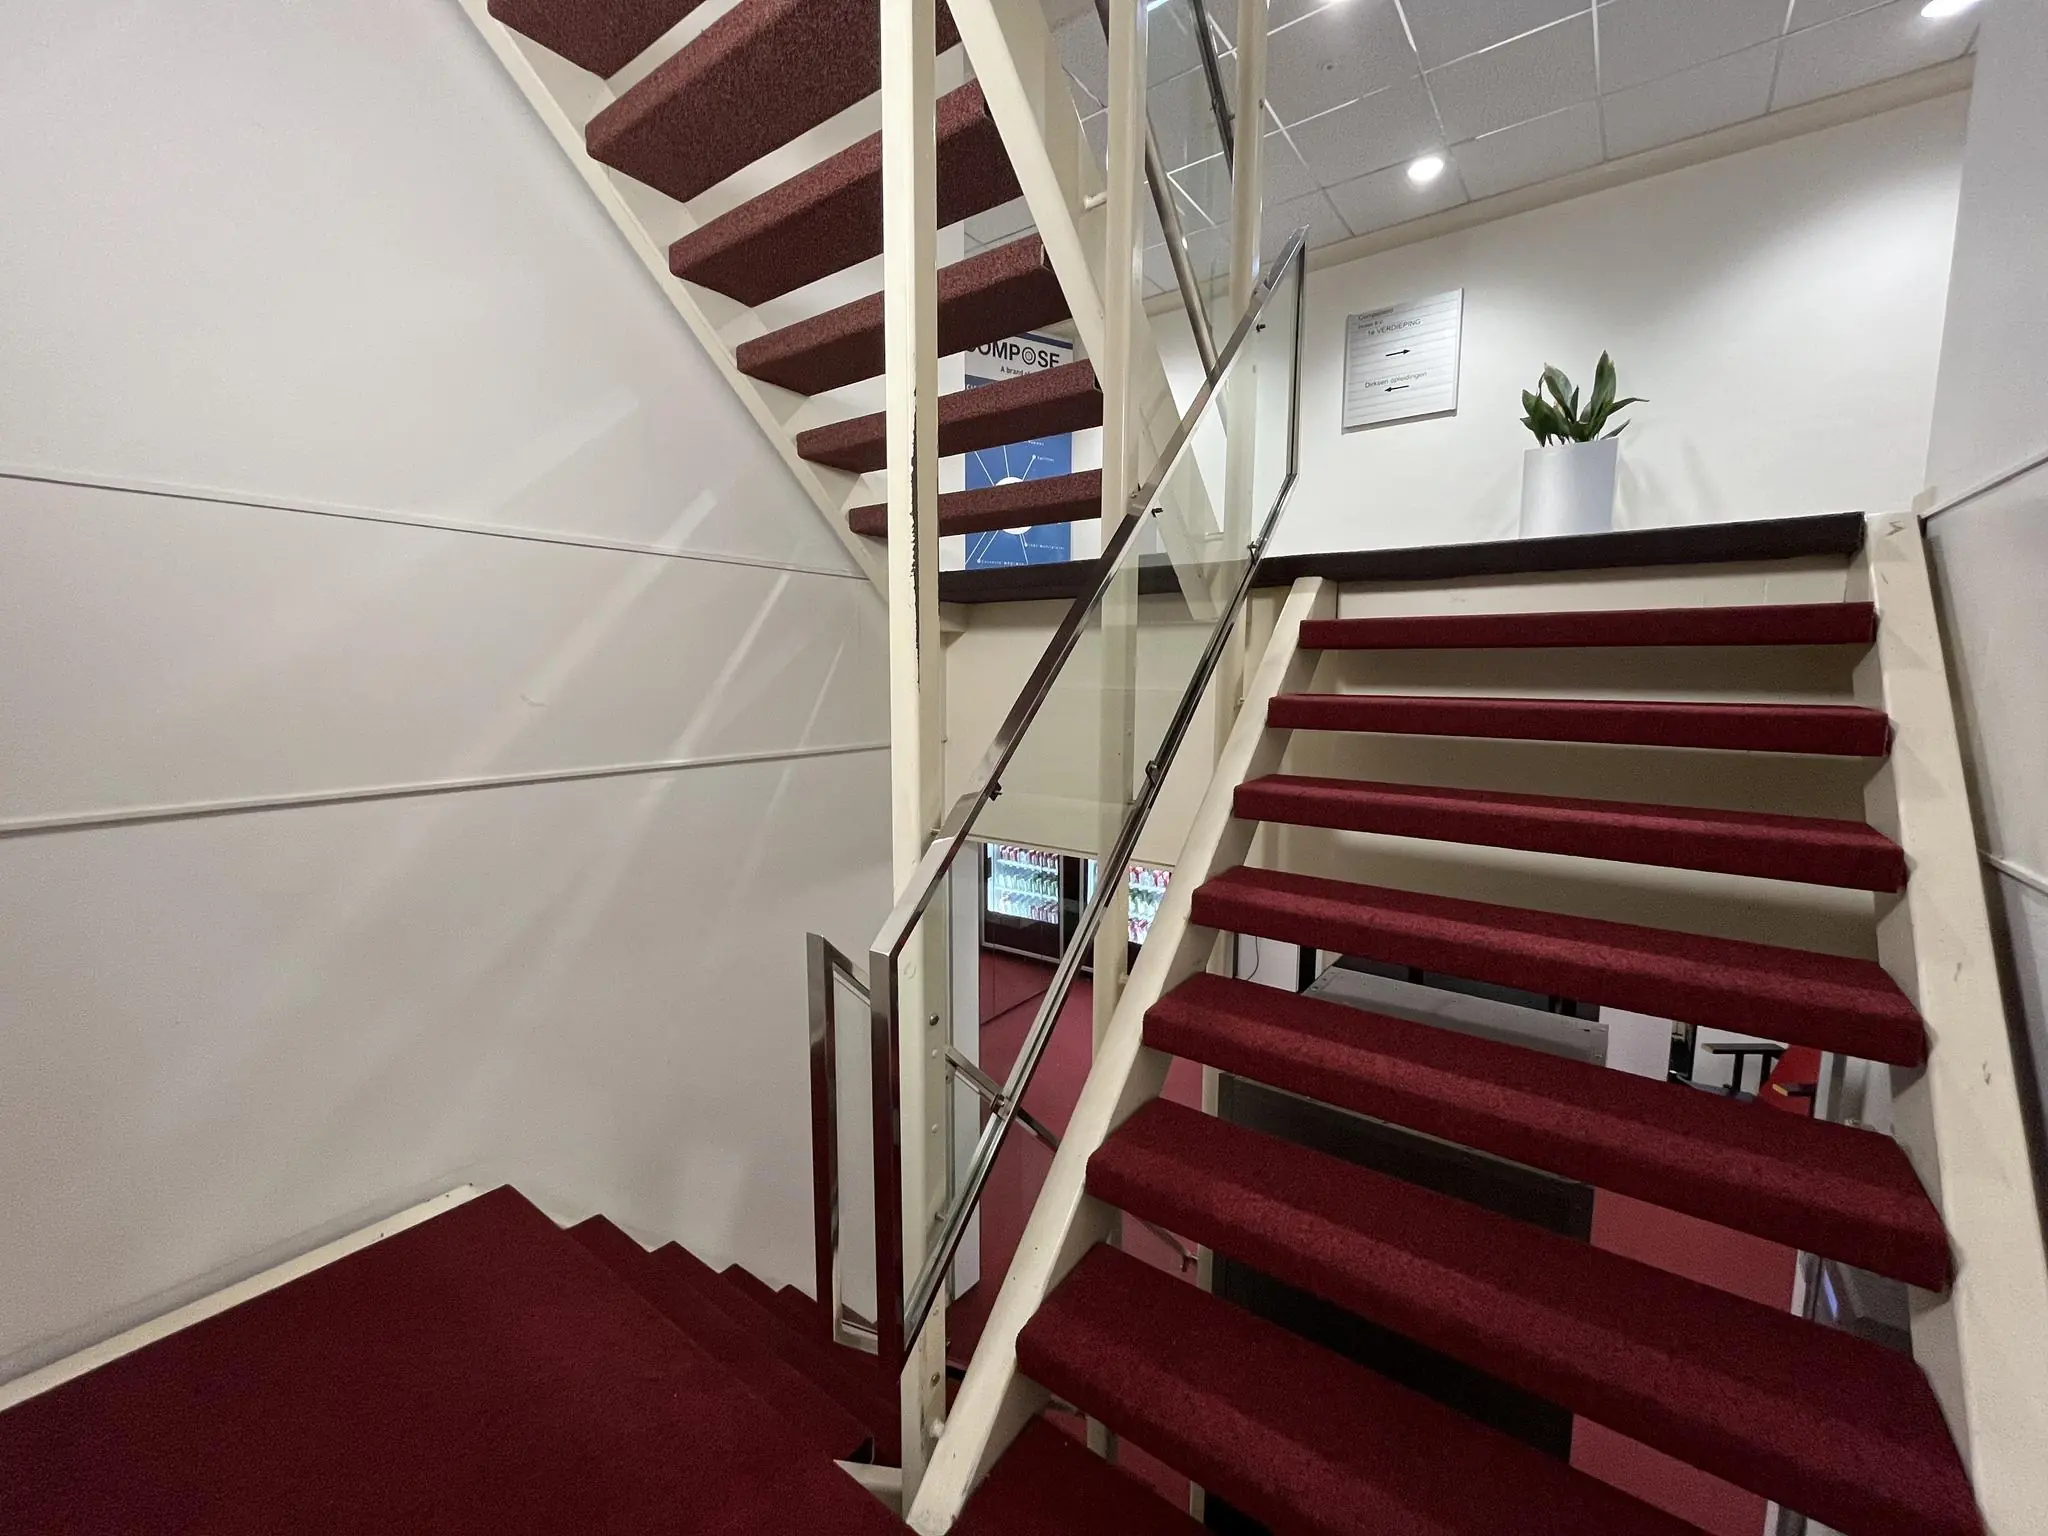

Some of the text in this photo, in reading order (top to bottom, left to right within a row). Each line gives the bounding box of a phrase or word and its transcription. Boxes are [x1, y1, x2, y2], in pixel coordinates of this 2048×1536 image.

[1376, 319, 1421, 334] VERDIEPING
[968, 342, 1060, 368] OMPOSE
[1364, 372, 1427, 388] Dirksen opleidingen
